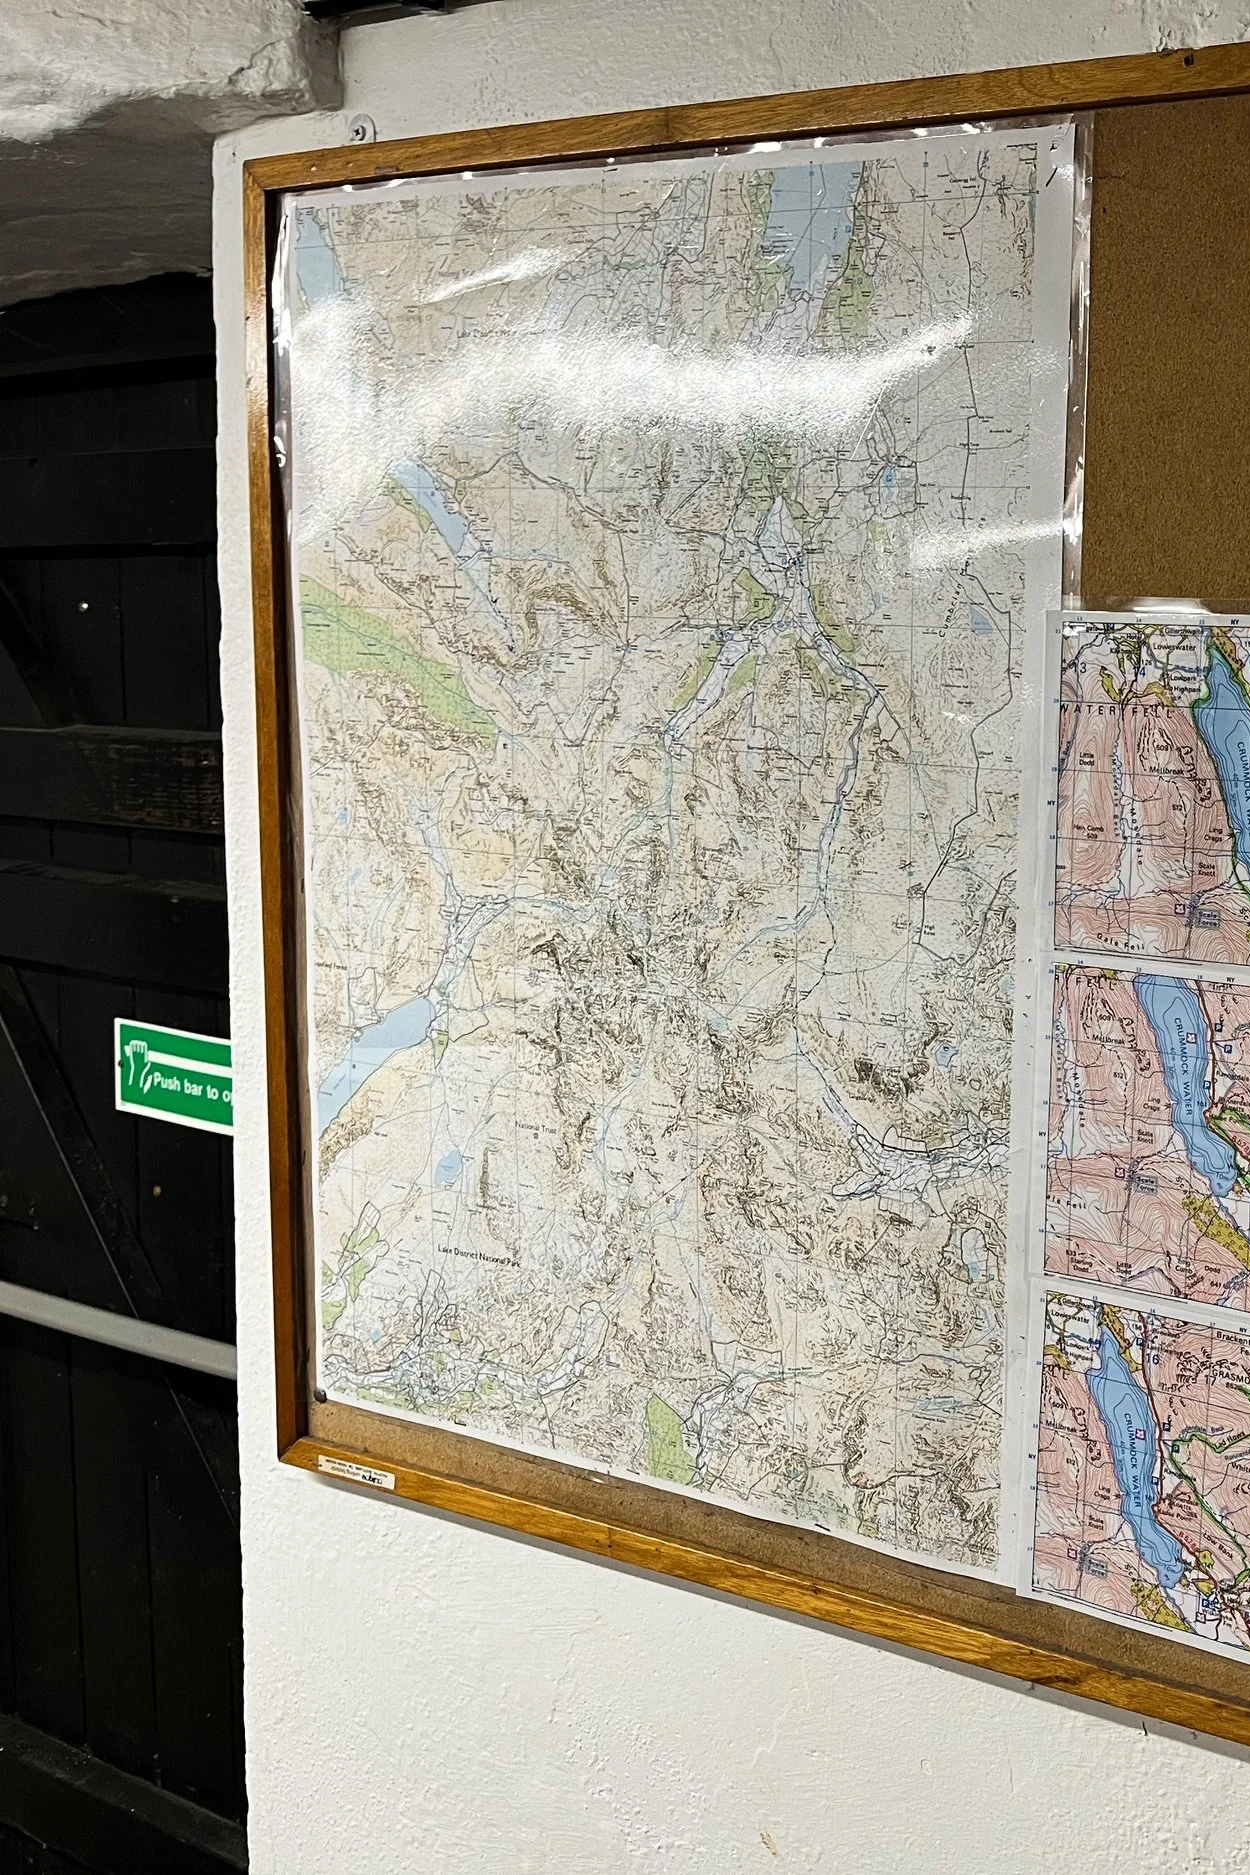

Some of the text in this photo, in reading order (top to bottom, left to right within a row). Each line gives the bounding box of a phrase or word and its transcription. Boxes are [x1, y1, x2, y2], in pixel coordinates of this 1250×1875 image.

[154, 1072, 180, 1092] Push
[184, 1078, 202, 1096] bar
[206, 1085, 219, 1100] to
[1174, 1017, 1193, 1116] CRUMMOCK WATER
[438, 1244, 452, 1254] Lake
[454, 1248, 478, 1260] District
[480, 1252, 507, 1264] National
[1124, 1412, 1142, 1508] CRUMMOCK WATER
